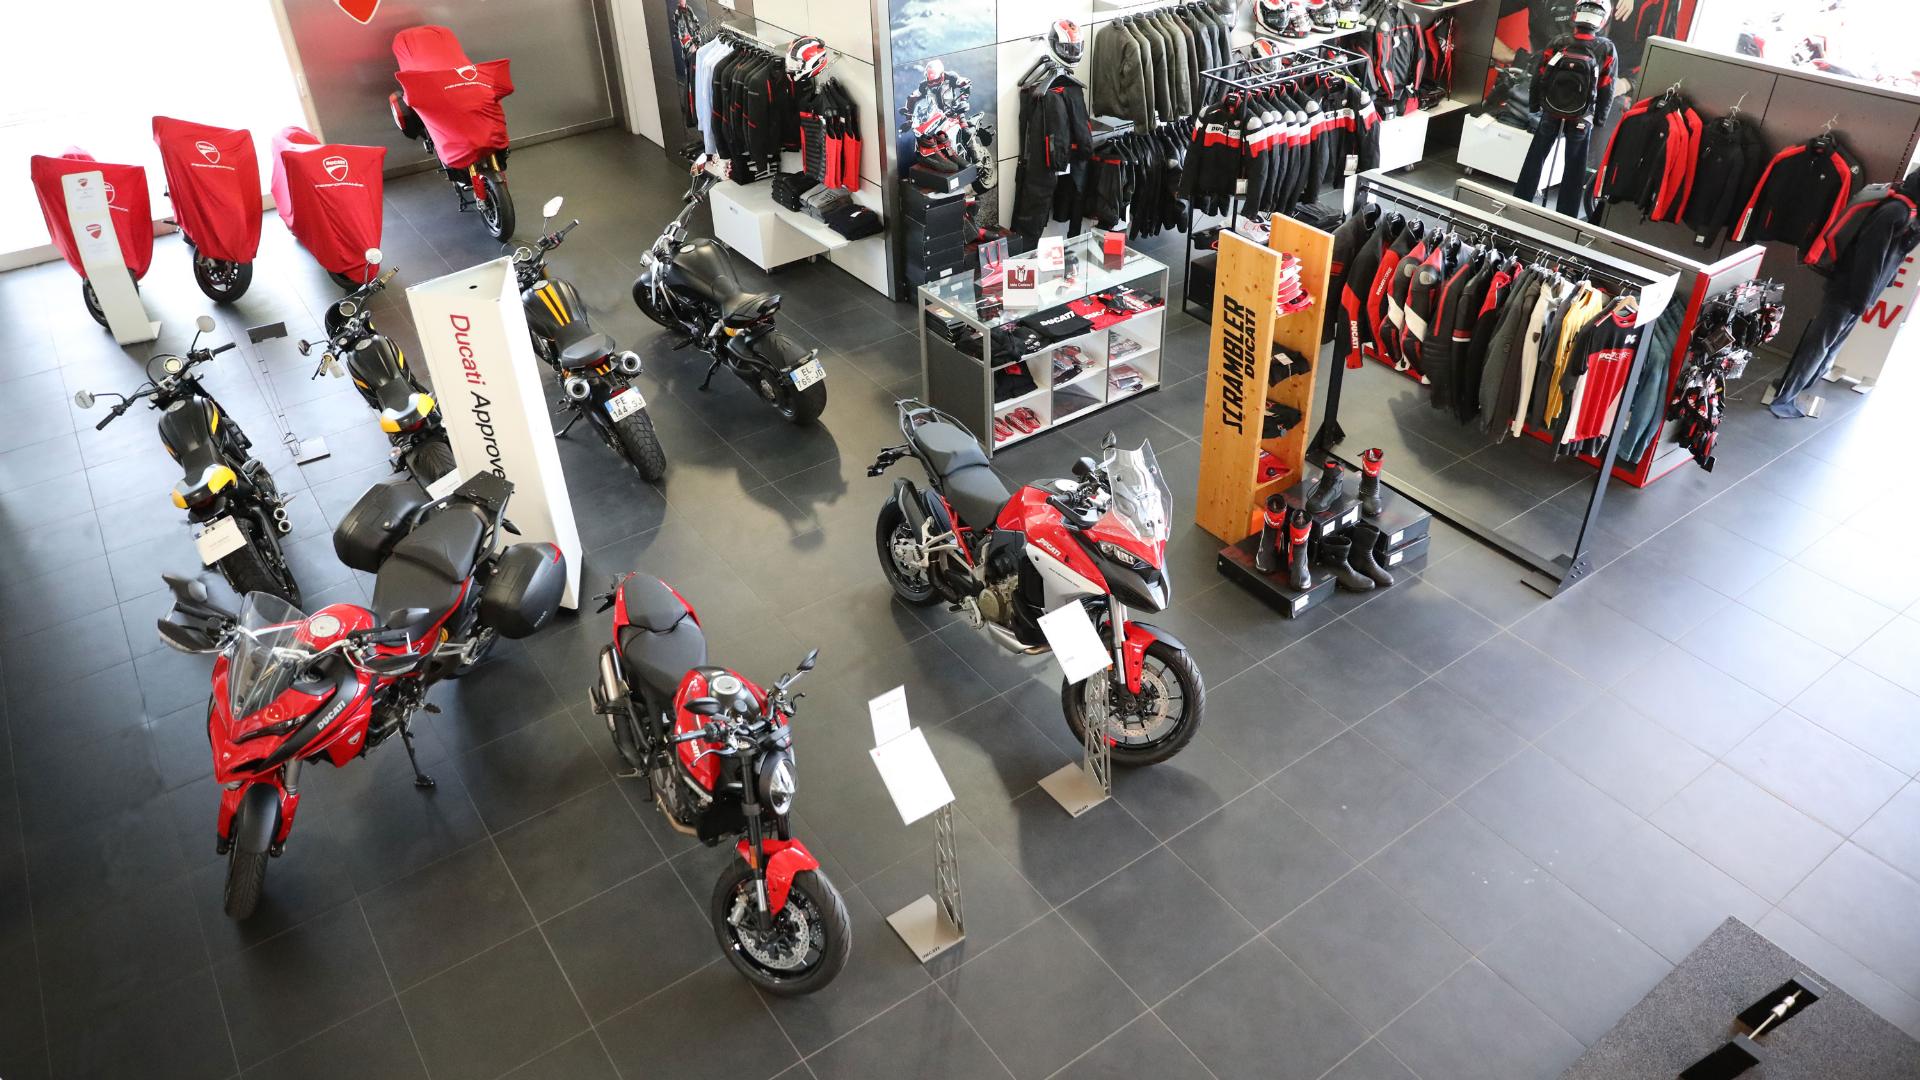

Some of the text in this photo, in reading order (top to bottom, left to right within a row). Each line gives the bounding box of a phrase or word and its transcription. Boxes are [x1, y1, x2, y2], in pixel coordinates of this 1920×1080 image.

[1040, 310, 1076, 326] DUCATI
[1244, 307, 1256, 380] DUCATI
[1350, 320, 1359, 349] DUCATI
[1222, 294, 1245, 436] SCRAMBLER
[450, 314, 506, 480] Ducati Approve
[1035, 537, 1062, 557] DUCATI
[317, 699, 346, 730] DUCATI
